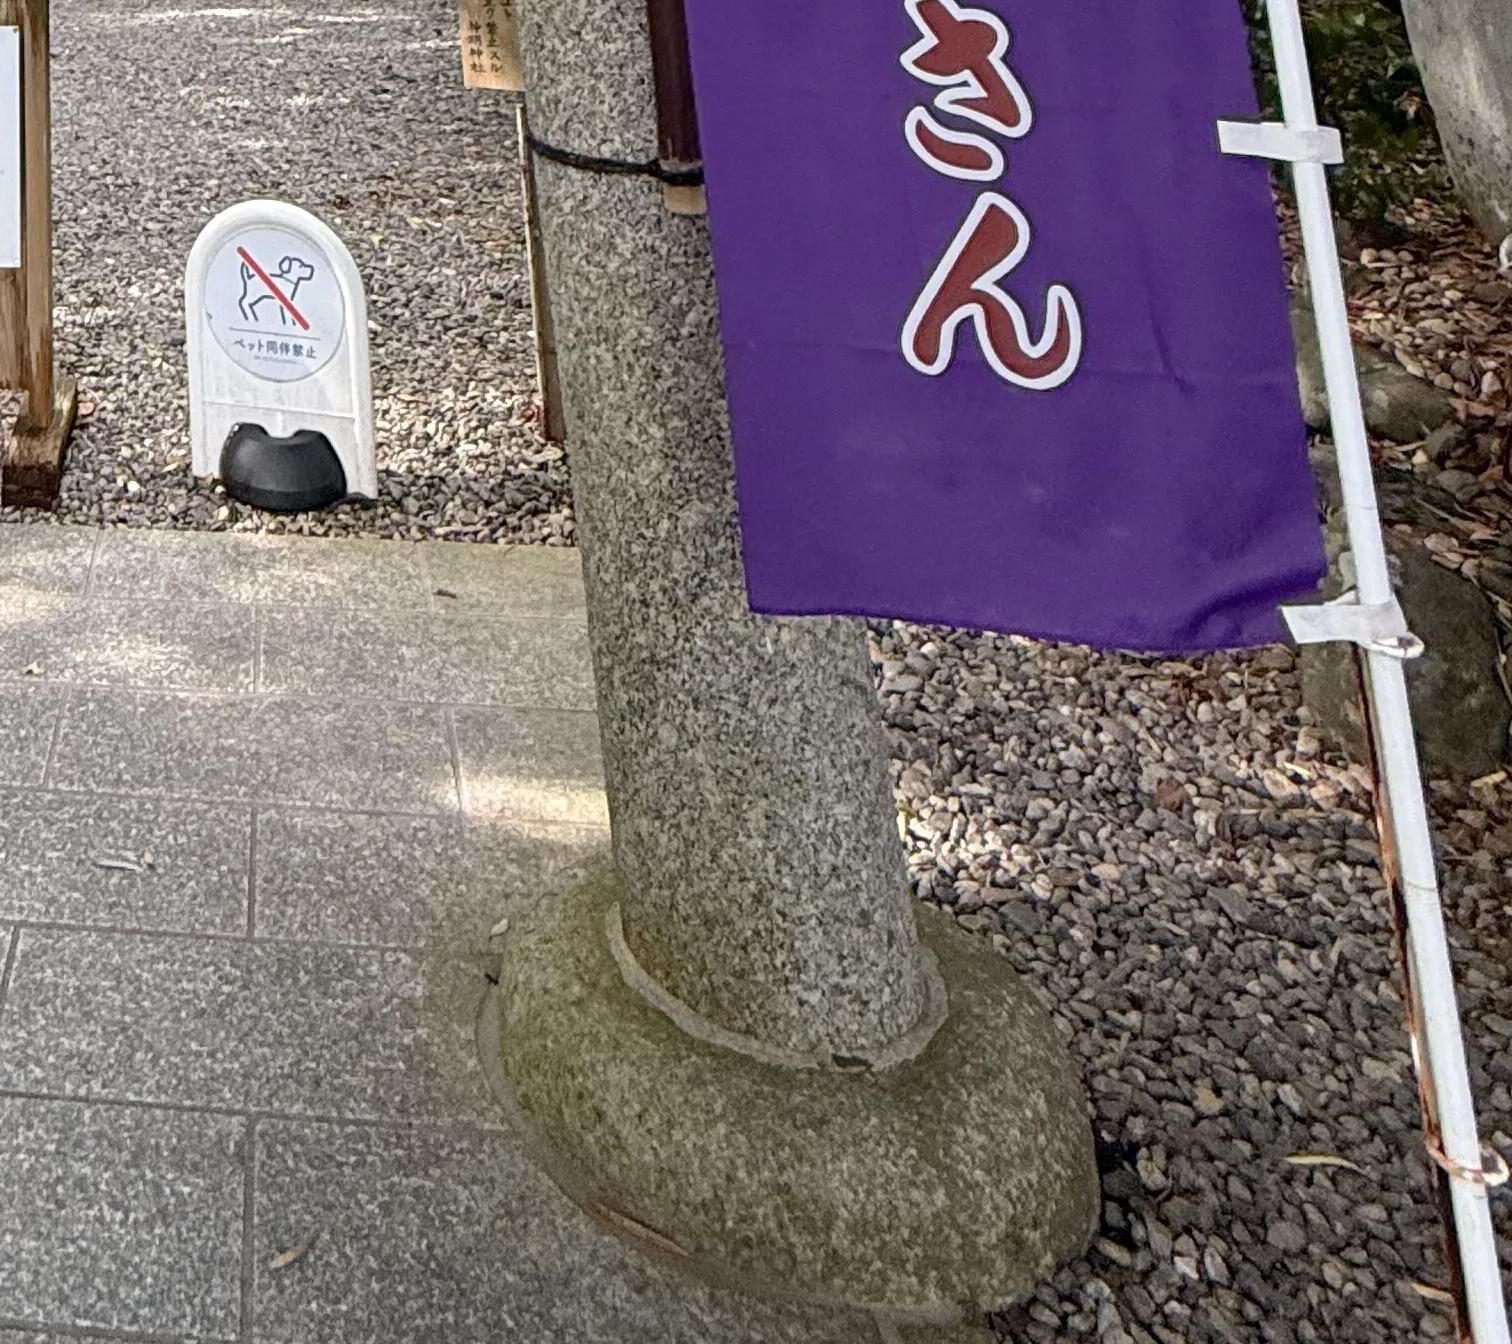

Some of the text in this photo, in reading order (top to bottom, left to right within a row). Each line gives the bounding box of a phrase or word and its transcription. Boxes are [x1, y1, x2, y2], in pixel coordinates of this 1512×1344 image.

[467, 19, 487, 74] 神明神社
[232, 337, 318, 360] ペット同伴禁止
